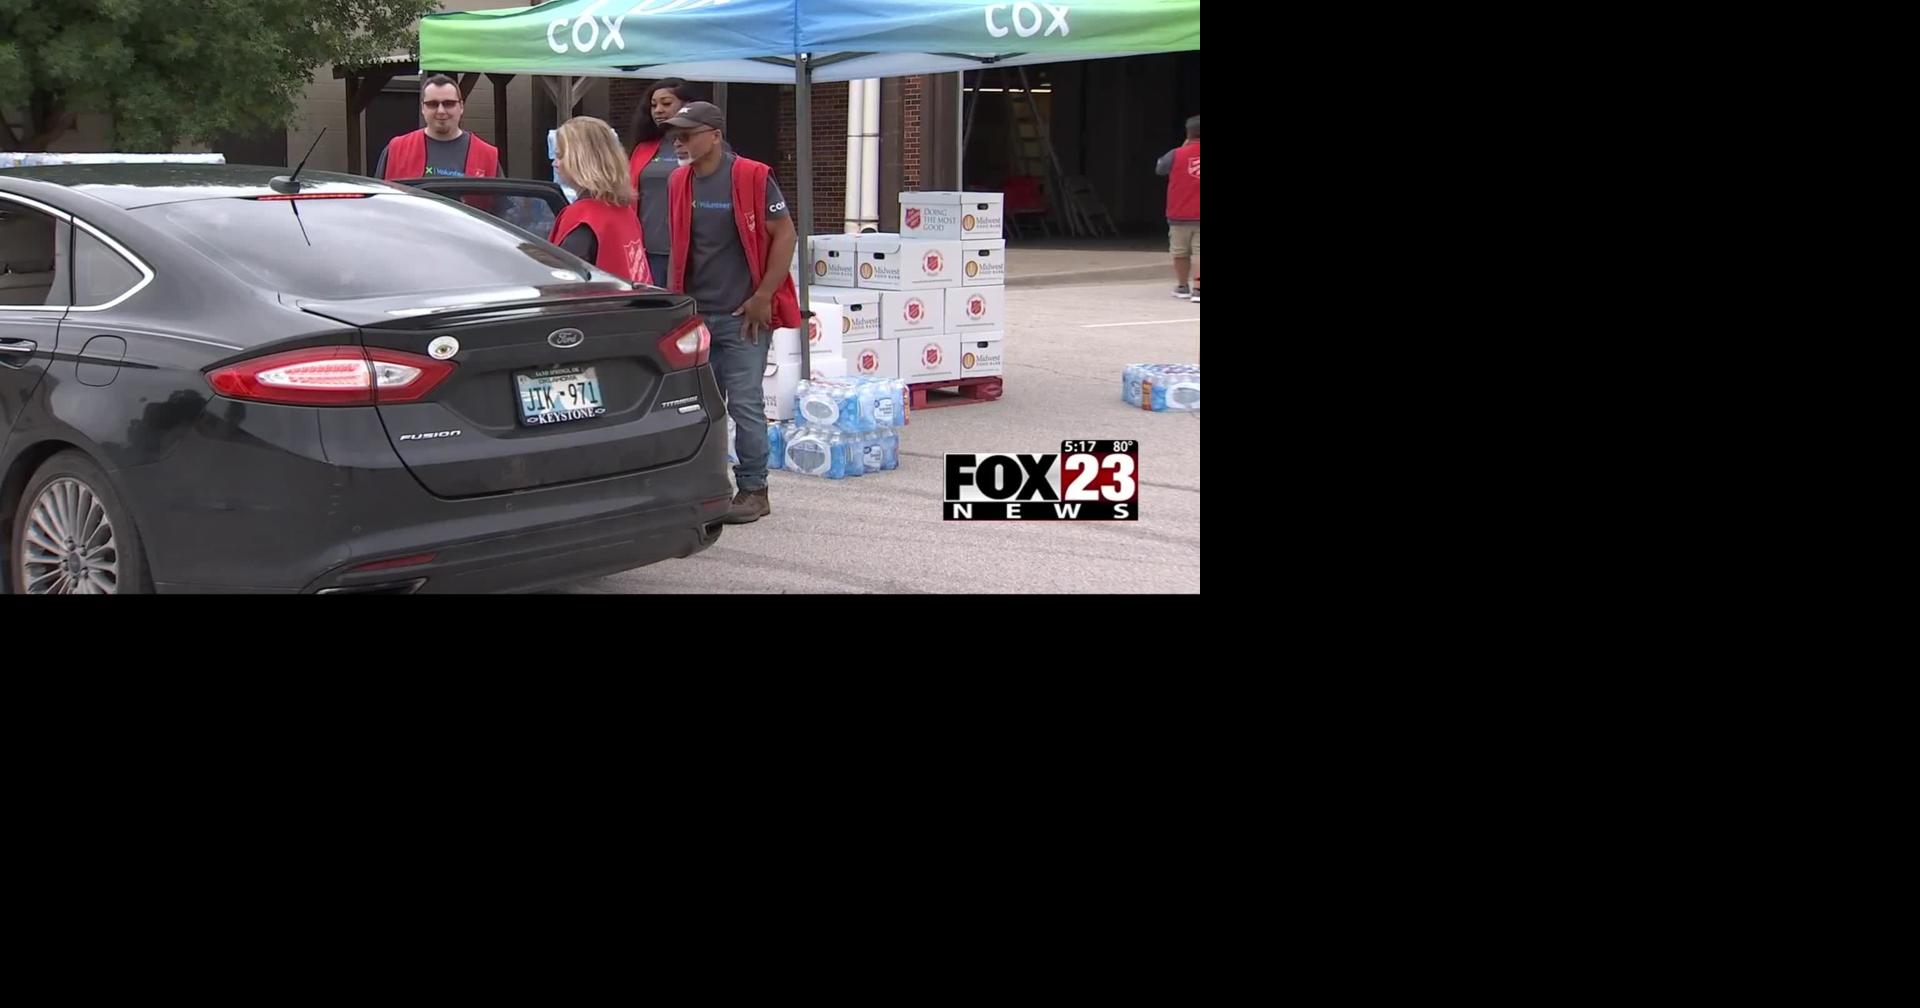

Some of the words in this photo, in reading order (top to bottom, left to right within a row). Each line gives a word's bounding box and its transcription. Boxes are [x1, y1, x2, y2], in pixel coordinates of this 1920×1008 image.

[984, 1, 1069, 37] COX
[547, 14, 625, 53] COX
[924, 208, 947, 216] DOING
[874, 265, 900, 274] Midwest
[557, 332, 578, 344] Ford
[539, 407, 596, 424] KEYSTONE
[400, 430, 461, 441] FUSION
